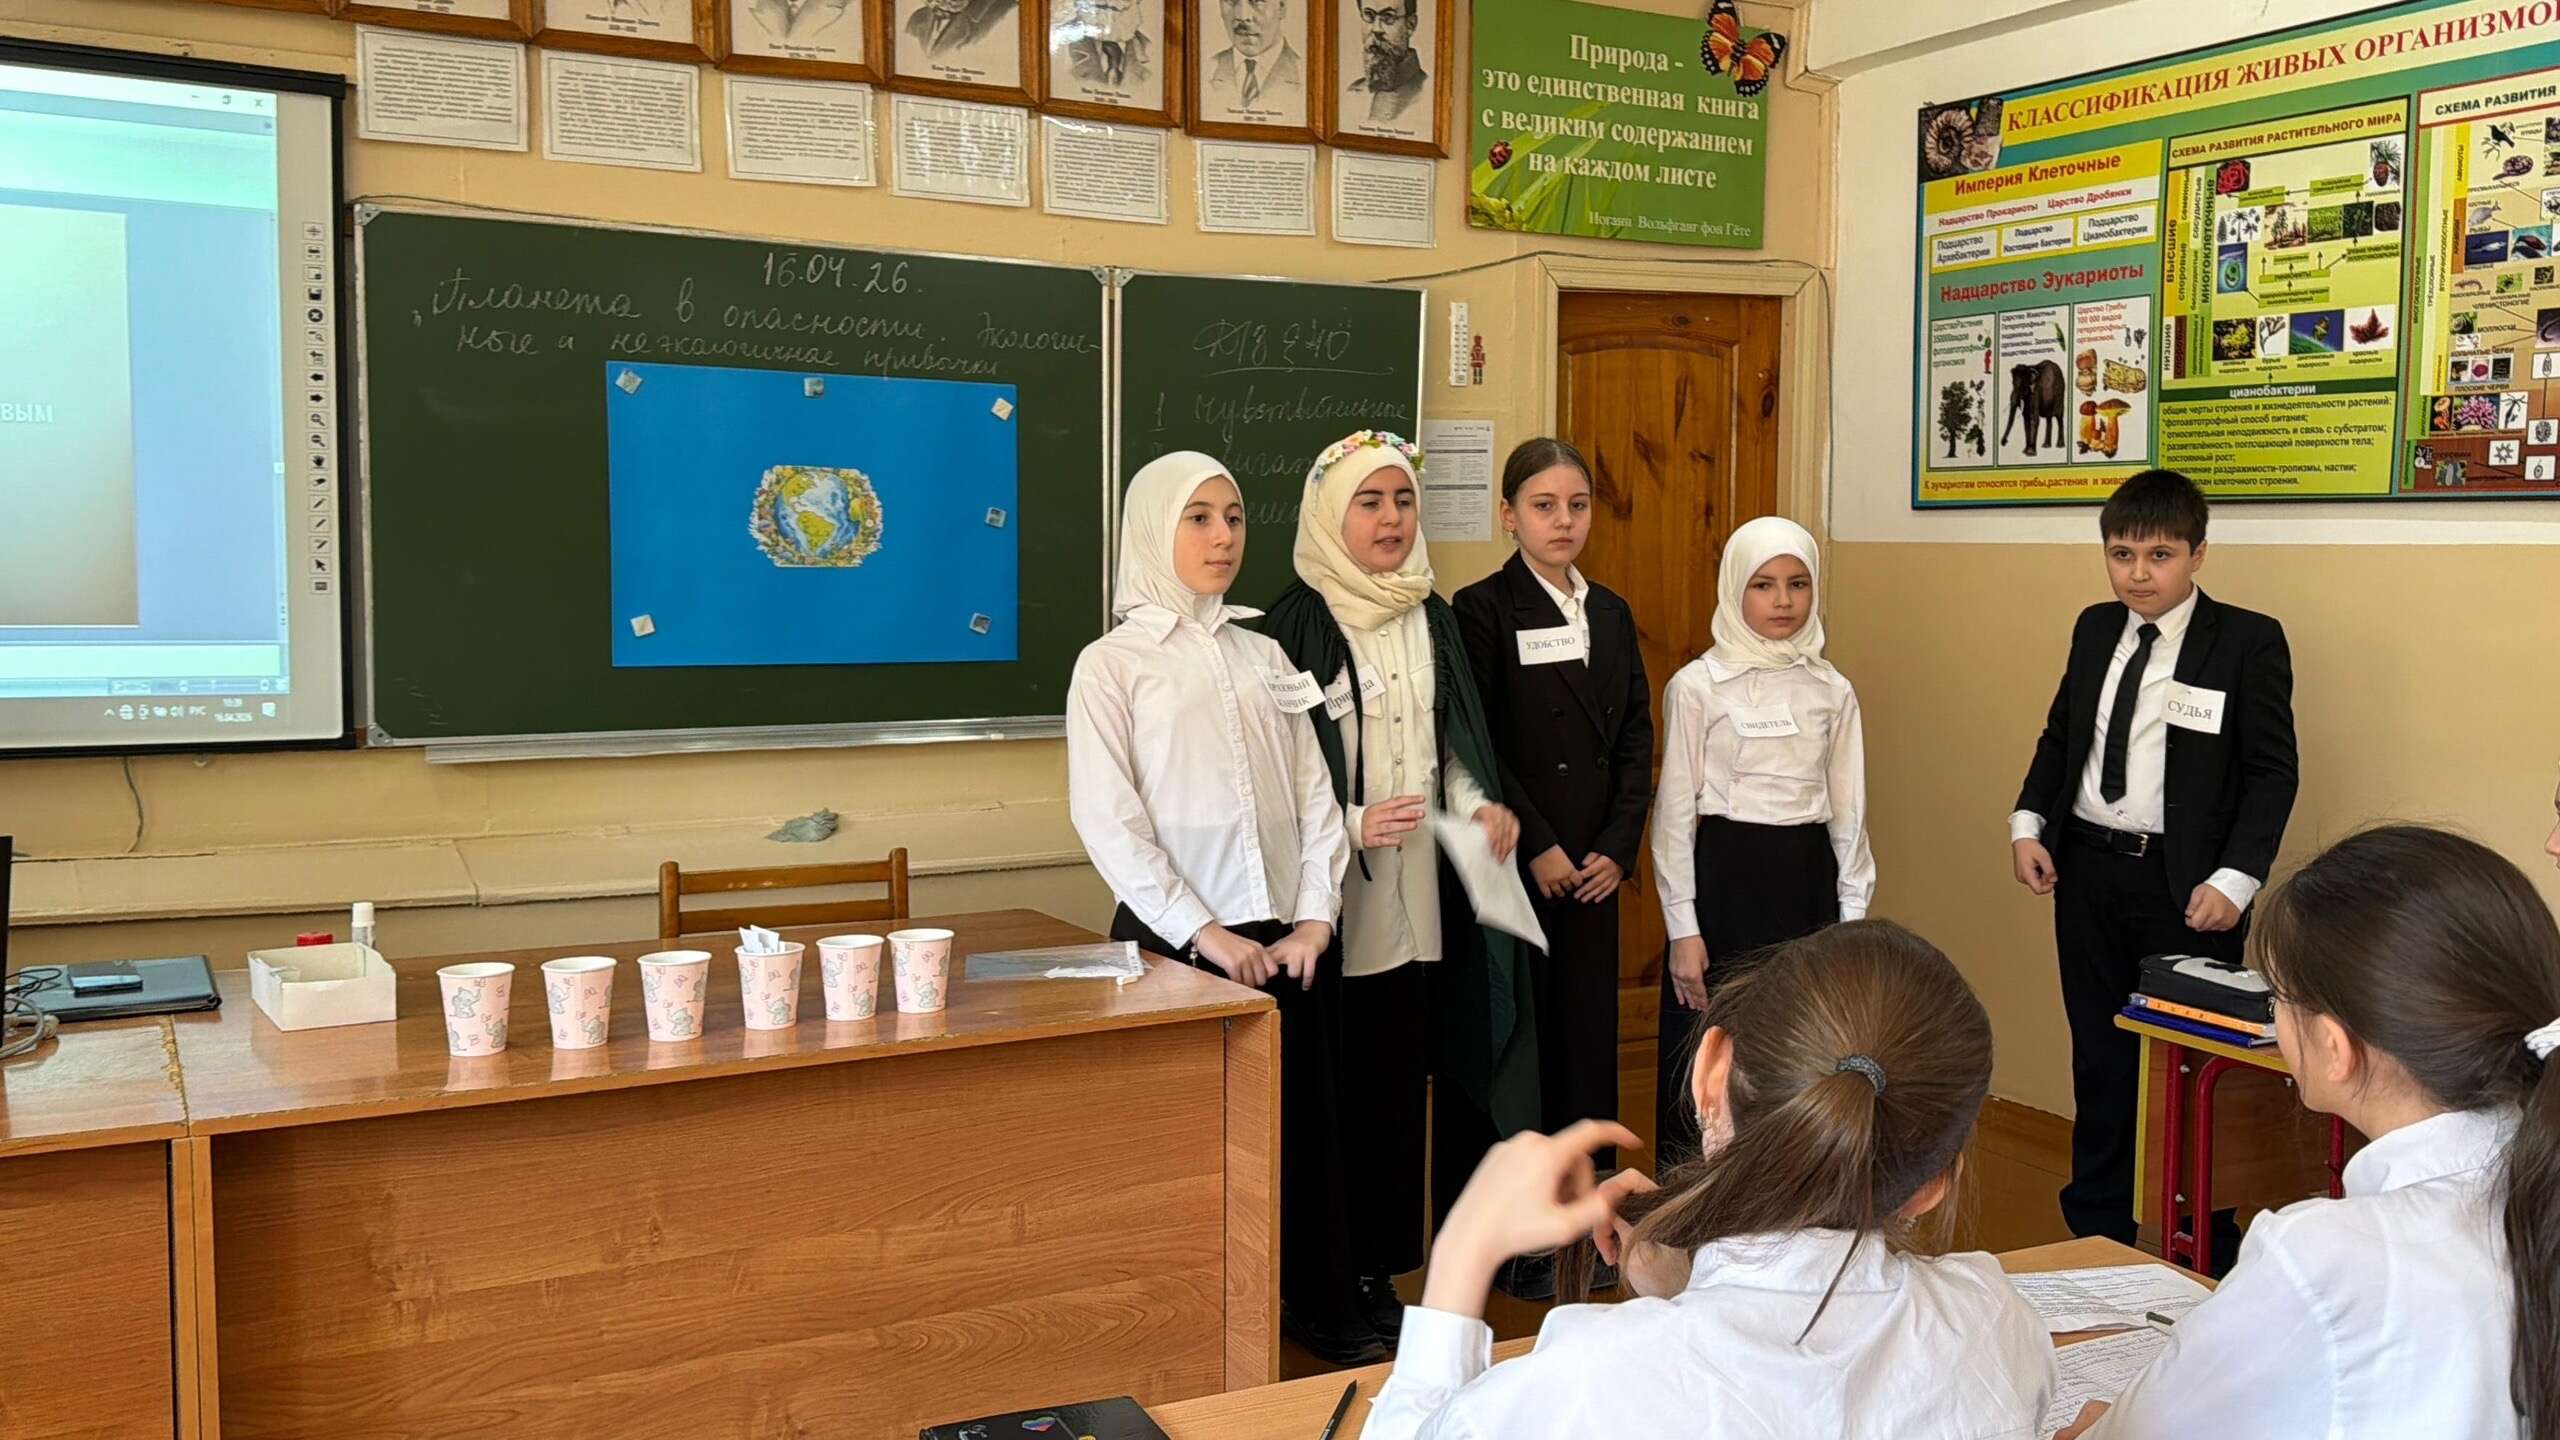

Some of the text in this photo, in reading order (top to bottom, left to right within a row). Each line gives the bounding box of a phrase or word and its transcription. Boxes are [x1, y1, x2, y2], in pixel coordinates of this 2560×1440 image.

[1569, 34, 1669, 74] Природа
[2007, 1, 2560, 132] КЛАССИФИКАЦИЯ ЖИВЫХ ОРГАНИЗМО
[1482, 68, 1759, 120] это единственная книга
[2435, 85, 2557, 116] СХЕМА РАЗВИТИЯ
[1482, 108, 1753, 156] с великим содержанием
[2171, 111, 2402, 160] СХЕМА РАЗВИТИЯ РАСТИТЕЛЬНОГО МИРА
[1528, 151, 1718, 189] на каждом листе
[1955, 153, 2121, 196] Империя Клеточные
[2047, 187, 2132, 210] Царство Дробянки
[1588, 211, 1750, 237] Иоганн Вольфганг фон Гёте
[1938, 203, 2039, 228] Надцарство Прокариоты
[2088, 212, 2139, 229] Подцарство
[1937, 234, 1984, 250] Подцарство
[2083, 225, 2149, 243] Цианобактерии
[1940, 263, 2144, 303] Надцарство Эукариоты
[2229, 383, 2317, 399] цианобактерии
[0, 402, 54, 423] ВЫМ
[2162, 405, 2188, 415] общие
[2188, 405, 2214, 415] черты
[2214, 403, 2253, 414] строения
[2261, 399, 2346, 411] жизнедеятельности
[2226, 426, 2291, 437] неподвижность
[2299, 425, 2325, 434] связь
[2333, 422, 2387, 435] субстратом;
[2240, 414, 2270, 425] способ
[2271, 413, 2309, 423] питания;
[2294, 438, 2350, 448] поверхности
[2351, 437, 2374, 447] тела;
[2166, 452, 2236, 464] постоянный рост;
[1976, 479, 2018, 489] относятся
[1526, 636, 1575, 650] УДОБСТВО
[2167, 699, 2213, 720] СУДЬЯ
